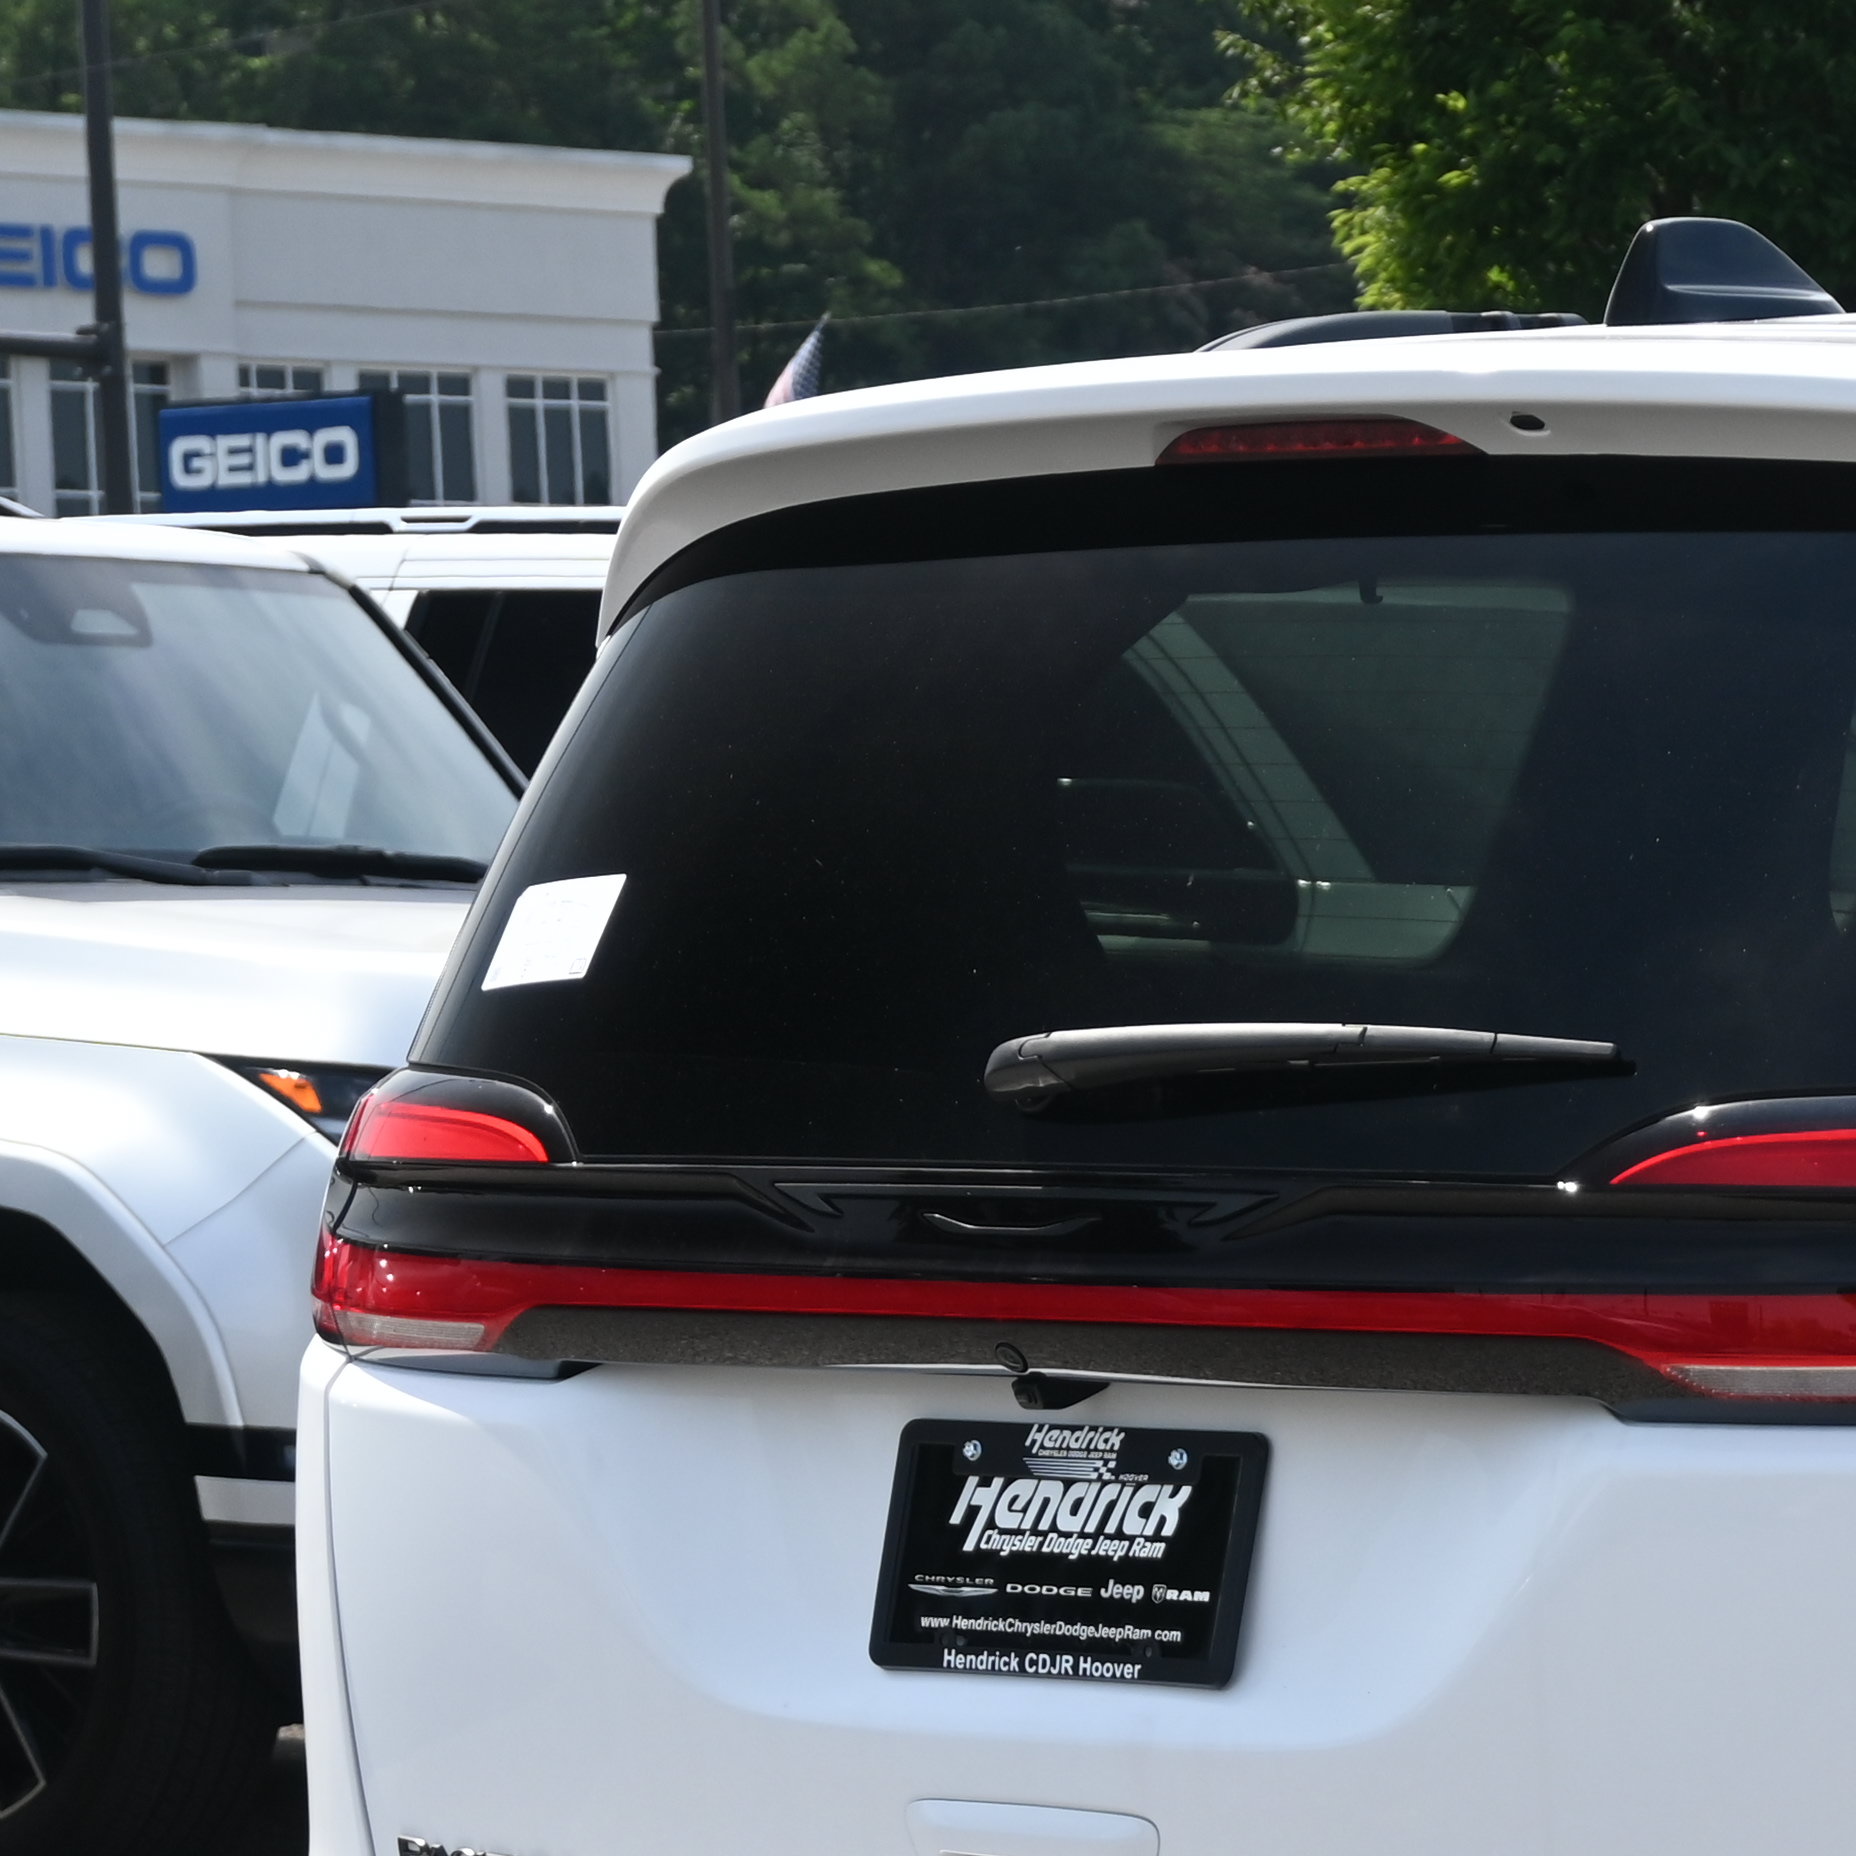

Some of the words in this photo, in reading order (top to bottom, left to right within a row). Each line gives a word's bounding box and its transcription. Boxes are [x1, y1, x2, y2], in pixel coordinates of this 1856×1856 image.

[169, 425, 360, 491] GEICO
[1025, 1423, 1125, 1454] Hendrick
[949, 1475, 1192, 1551] Hendrick
[980, 1529, 1044, 1556] Chrysler
[1045, 1533, 1091, 1559] Dodge
[1091, 1535, 1130, 1560] Jeep
[1131, 1536, 1166, 1559] Ram
[914, 1574, 995, 1585] CHRYSLER
[1006, 1583, 1093, 1597] DODGE
[1100, 1579, 1145, 1602] Jeep
[1165, 1589, 1211, 1602] RAM
[920, 1614, 1182, 1643] wwwHendrickChryslerDodgeJeepRamcom
[942, 1648, 1020, 1673] Hendrick
[1024, 1652, 1074, 1676] CDJR
[1078, 1658, 1142, 1680] Hoover
